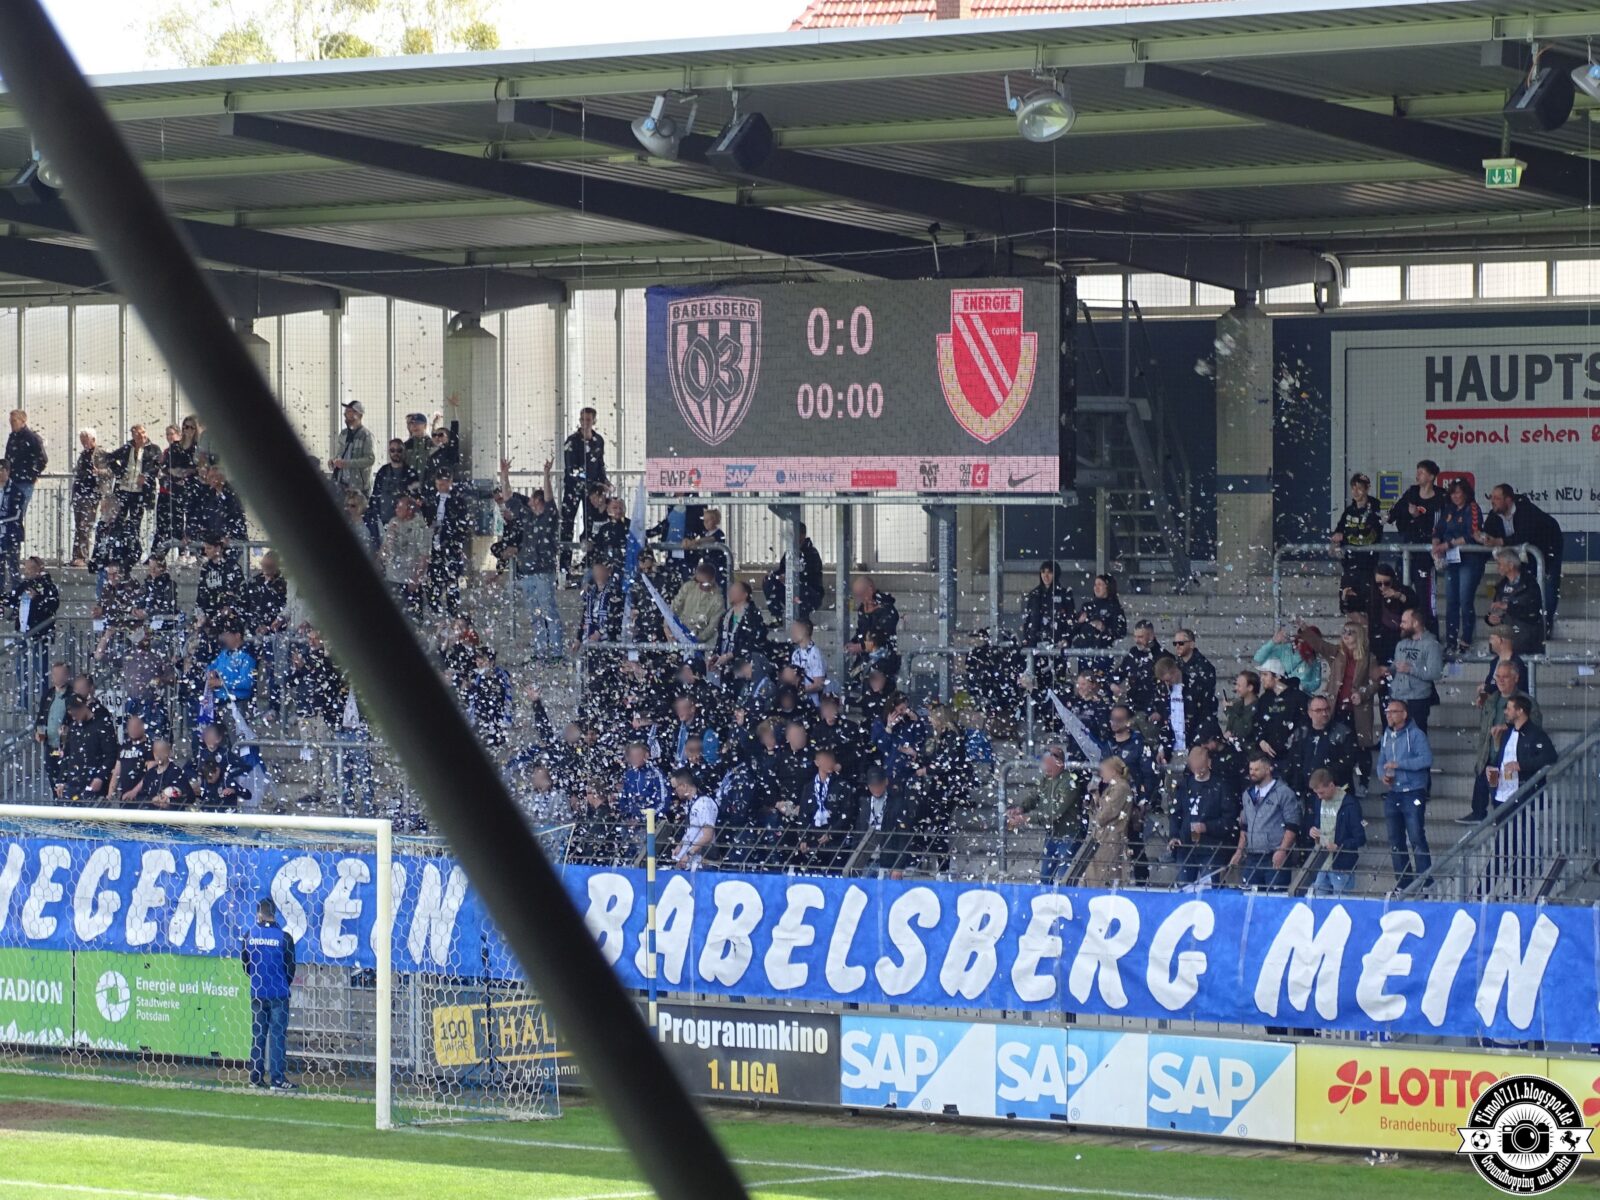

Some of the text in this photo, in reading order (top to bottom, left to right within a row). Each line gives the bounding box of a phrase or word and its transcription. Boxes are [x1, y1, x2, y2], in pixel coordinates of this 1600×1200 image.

[672, 301, 756, 319] BABELSBERG
[963, 295, 1011, 311] ENERGIE
[806, 305, 874, 356] 0:0
[991, 326, 1018, 336] COTTBUS
[797, 382, 884, 420] 00:00
[1425, 423, 1509, 449] Regional
[1520, 424, 1580, 442] sehen
[660, 470, 686, 486] EWP
[726, 469, 749, 483] SAP
[1555, 487, 1583, 500] NEU
[249, 938, 279, 947] ORDNER
[584, 872, 1215, 1010] BABELSBERG
[1254, 902, 1559, 1030] MEIN
[136, 976, 239, 997] Energie und Wasser
[136, 996, 180, 1009] Stadtwerke
[136, 1010, 170, 1022] Potsdam
[441, 1021, 467, 1040] 100
[481, 1012, 565, 1048] THAL
[658, 1012, 829, 1054] Programmkino
[840, 1030, 938, 1093] SAP
[707, 1059, 779, 1094] 1. LIGA
[997, 1041, 1088, 1104] SAP
[1148, 1051, 1256, 1118] SAP
[1380, 1116, 1457, 1136] Brandenburg
